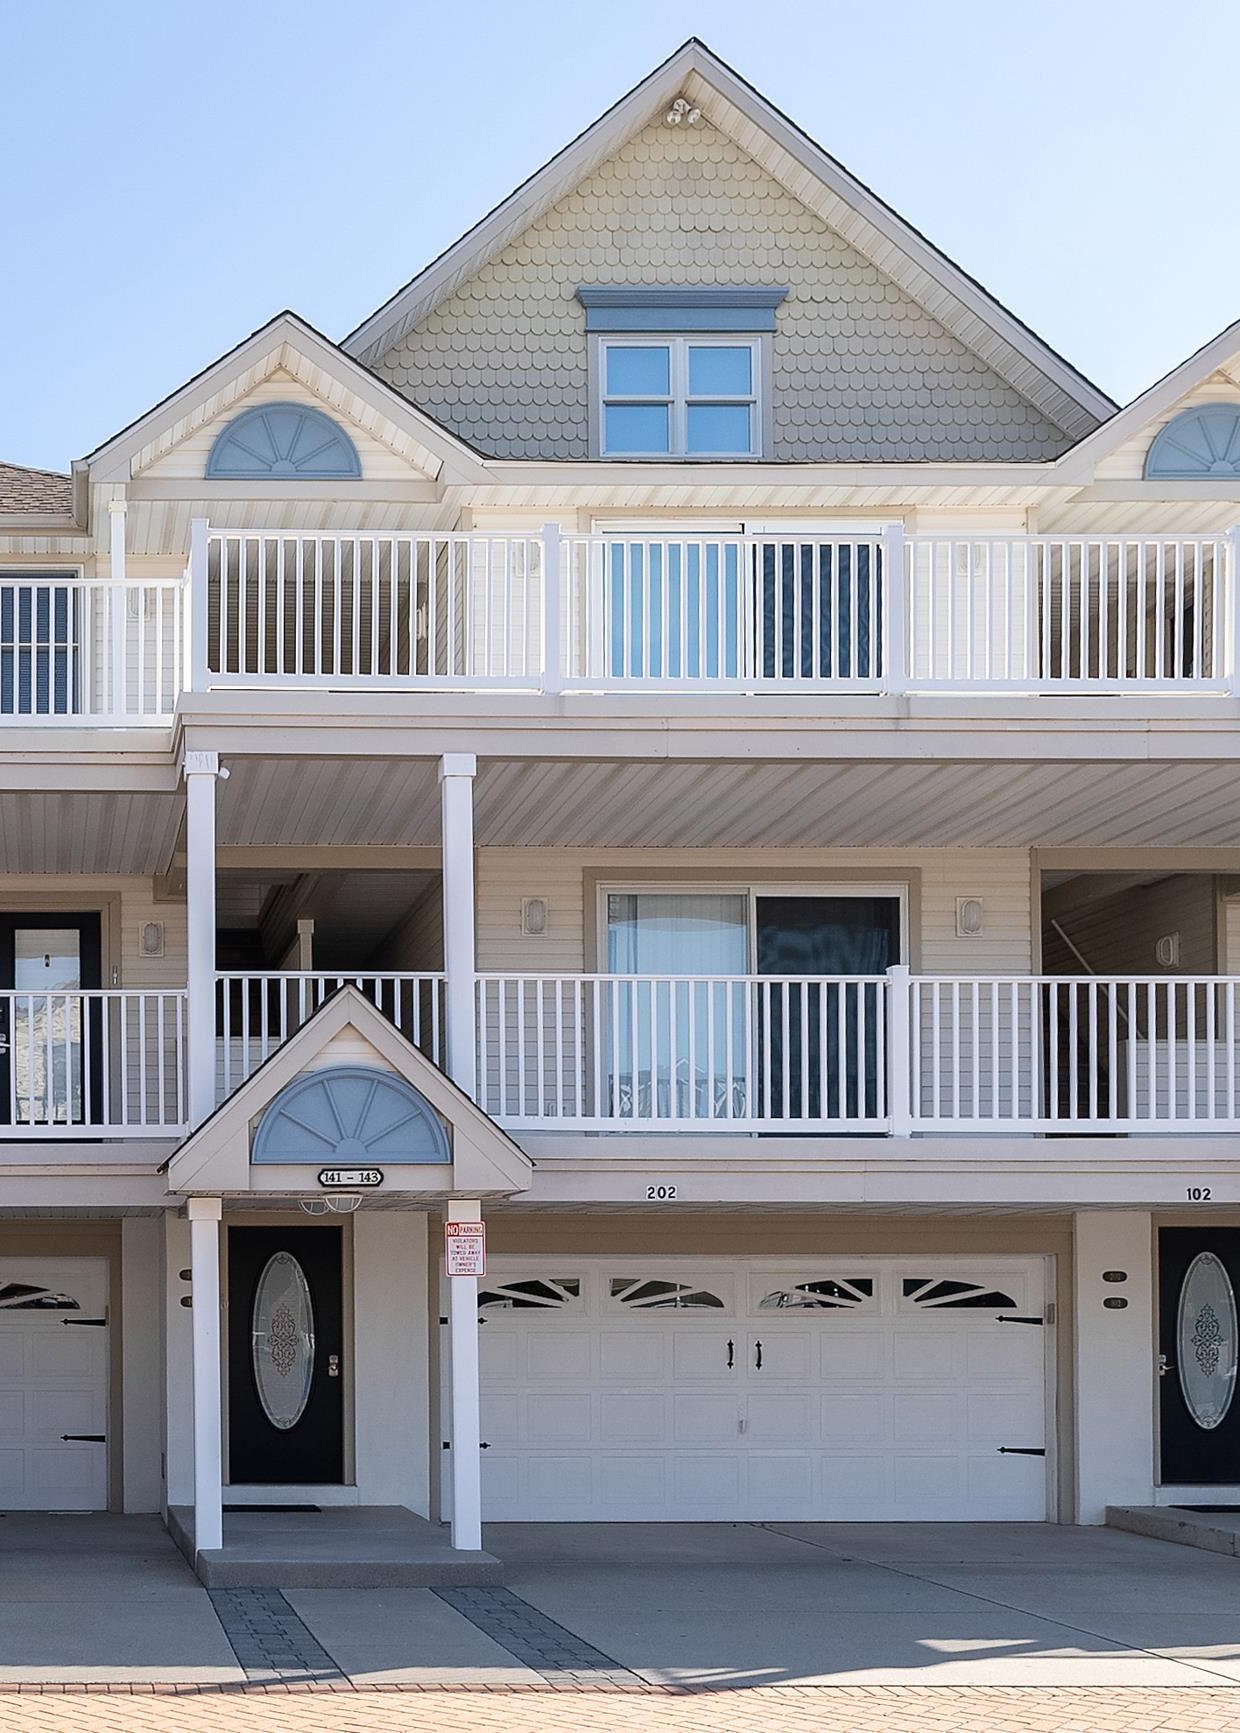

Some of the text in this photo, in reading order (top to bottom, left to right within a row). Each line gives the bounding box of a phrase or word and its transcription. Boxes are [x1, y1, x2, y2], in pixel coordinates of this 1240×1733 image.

[324, 1172, 342, 1182] 141
[358, 1172, 379, 1183] 143
[647, 1186, 676, 1199] 202
[1186, 1187, 1211, 1200] 102
[447, 1224, 482, 1236] NO PARKING
